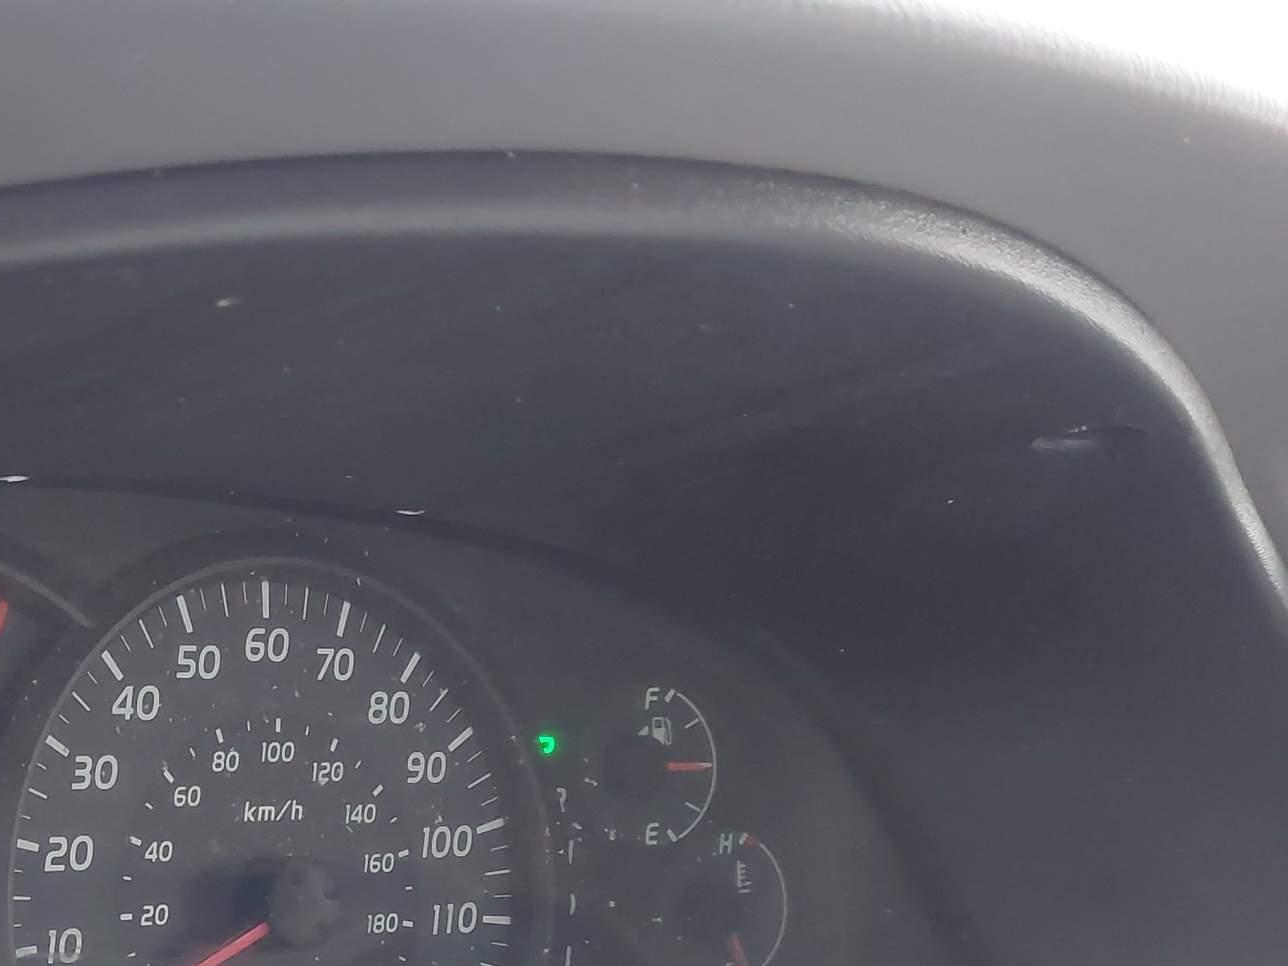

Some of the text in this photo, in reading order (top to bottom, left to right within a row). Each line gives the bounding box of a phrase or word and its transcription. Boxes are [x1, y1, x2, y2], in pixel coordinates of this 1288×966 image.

[246, 628, 289, 661] 60
[177, 645, 220, 679] 50
[317, 648, 354, 680] 70
[112, 686, 161, 720] 40
[369, 691, 409, 724] 80
[645, 688, 660, 709] F
[212, 752, 240, 772] 80
[262, 742, 294, 762] 100
[72, 755, 117, 789] 30
[312, 761, 344, 782] 120
[408, 752, 446, 783] 90
[174, 786, 200, 806] 60
[244, 800, 302, 821] km/h
[346, 804, 376, 824] 140
[423, 825, 472, 858] 100
[646, 823, 659, 845] E
[719, 833, 733, 854] H
[44, 835, 94, 872] 20
[145, 841, 172, 862] 40
[364, 853, 394, 873] 160
[141, 905, 168, 925] 20
[368, 913, 398, 933] 180
[433, 903, 477, 934] 110
[48, 928, 82, 964] 10
